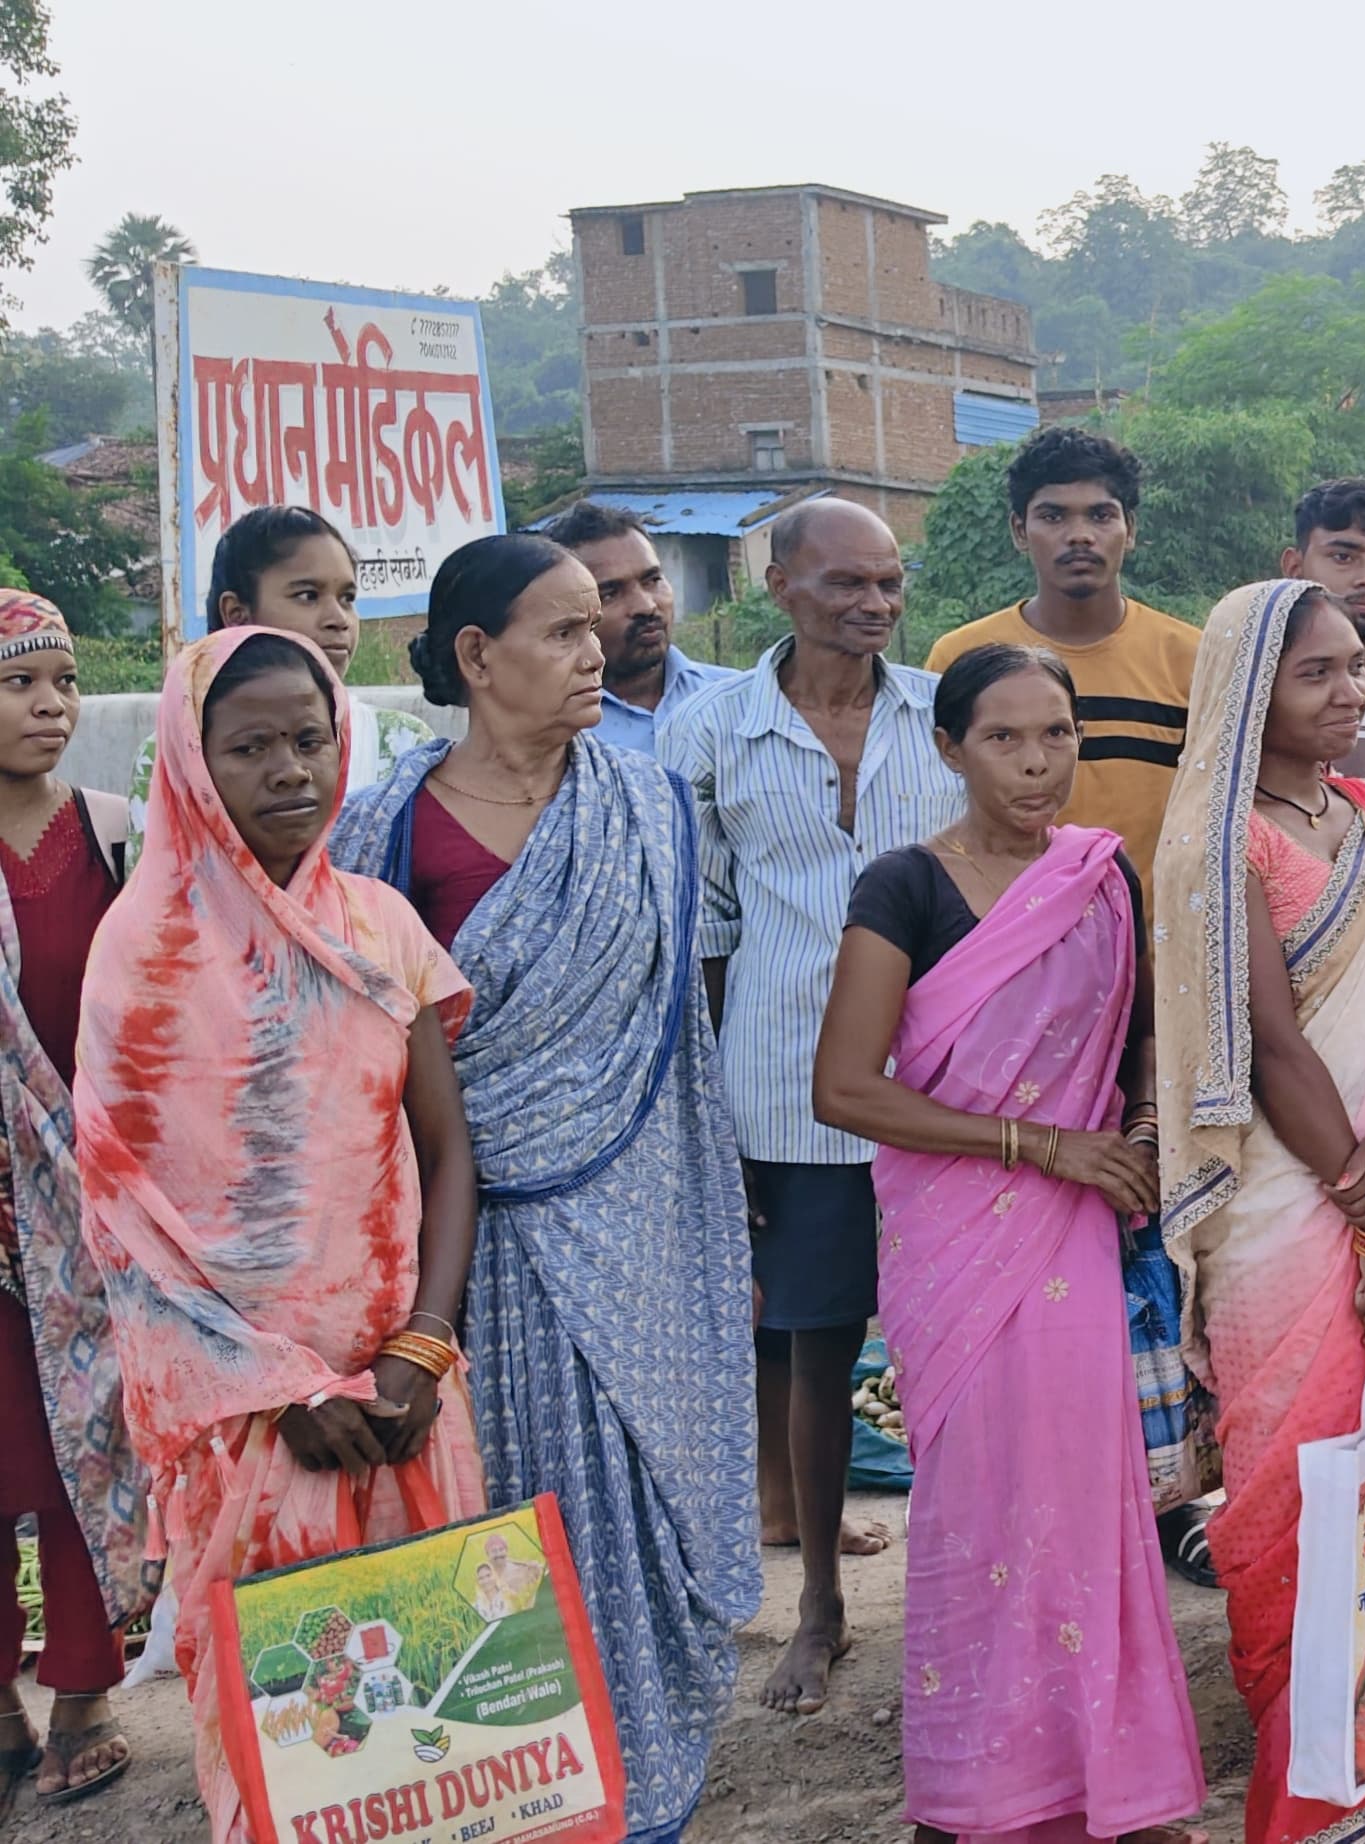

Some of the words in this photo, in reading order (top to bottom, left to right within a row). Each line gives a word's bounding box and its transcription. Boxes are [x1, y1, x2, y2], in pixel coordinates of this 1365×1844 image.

[193, 354, 321, 532] प्रधान
[476, 1689, 525, 1721] (Bendari
[526, 1678, 562, 1701] Wale)
[291, 1780, 434, 1844] KRISHI
[434, 1732, 585, 1821] DUNIYA
[460, 1816, 495, 1843] BEEJ
[519, 1793, 564, 1820] KHAD
